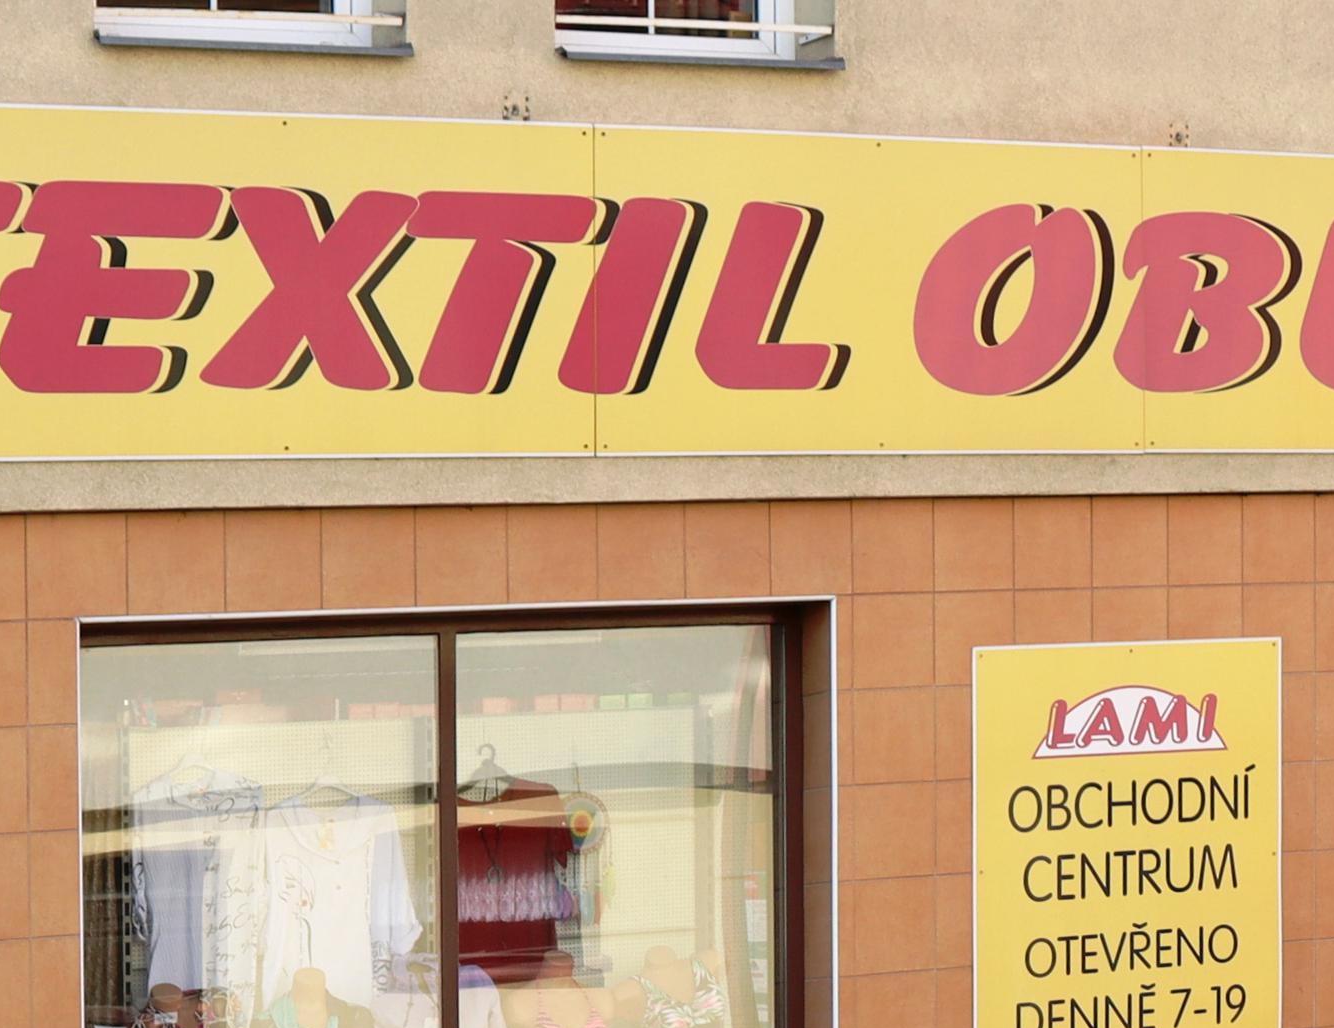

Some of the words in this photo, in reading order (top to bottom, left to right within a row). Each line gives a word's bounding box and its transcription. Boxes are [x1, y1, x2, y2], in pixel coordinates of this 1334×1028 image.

[1046, 693, 1218, 749] LAMI
[1008, 764, 1256, 833] OBCHODNÍ
[1023, 843, 1238, 902] CENTRUM
[1024, 922, 1239, 978] OTEVŘENO
[1170, 983, 1247, 1028] 7-19
